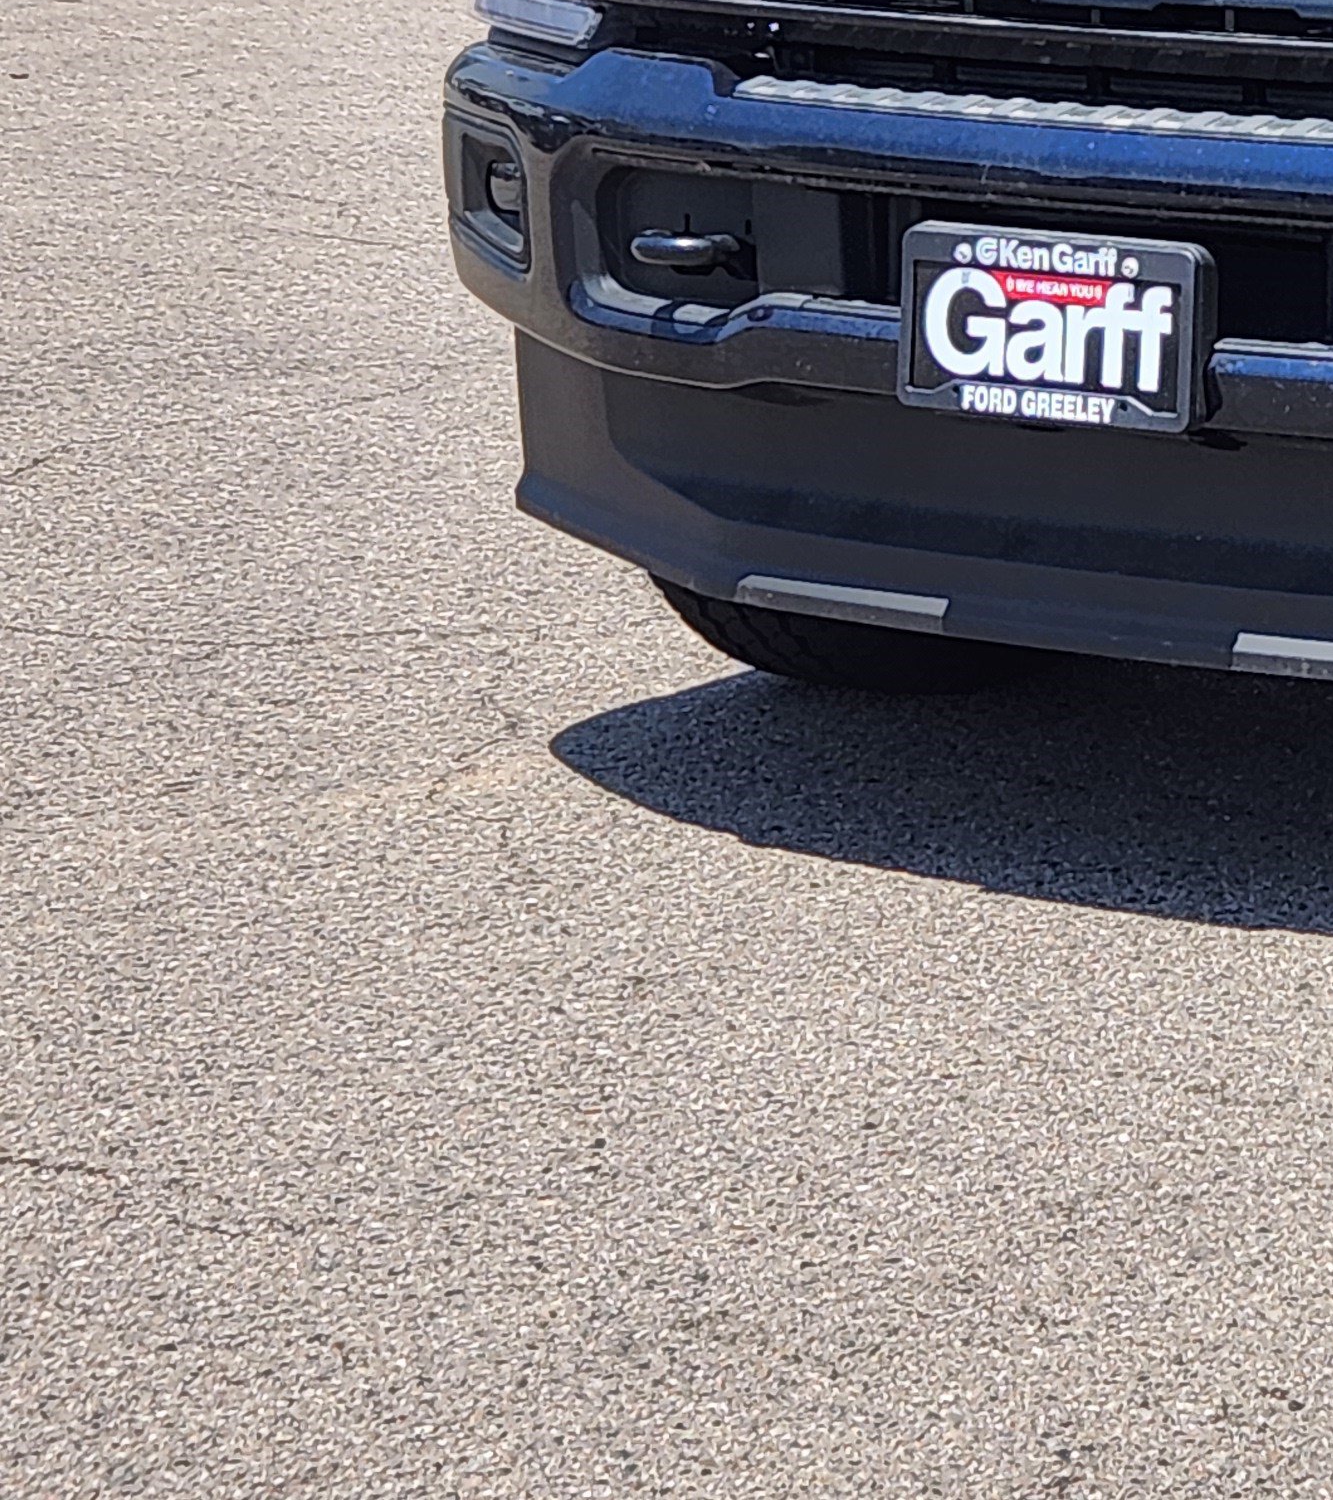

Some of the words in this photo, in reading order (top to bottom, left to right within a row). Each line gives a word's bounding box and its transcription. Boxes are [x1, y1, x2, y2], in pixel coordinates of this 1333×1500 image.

[999, 239, 1050, 271] Ken
[1051, 243, 1118, 277] Garff
[924, 266, 1173, 393] Garff
[960, 385, 1018, 415] FORD
[1021, 390, 1115, 425] GREELEY
